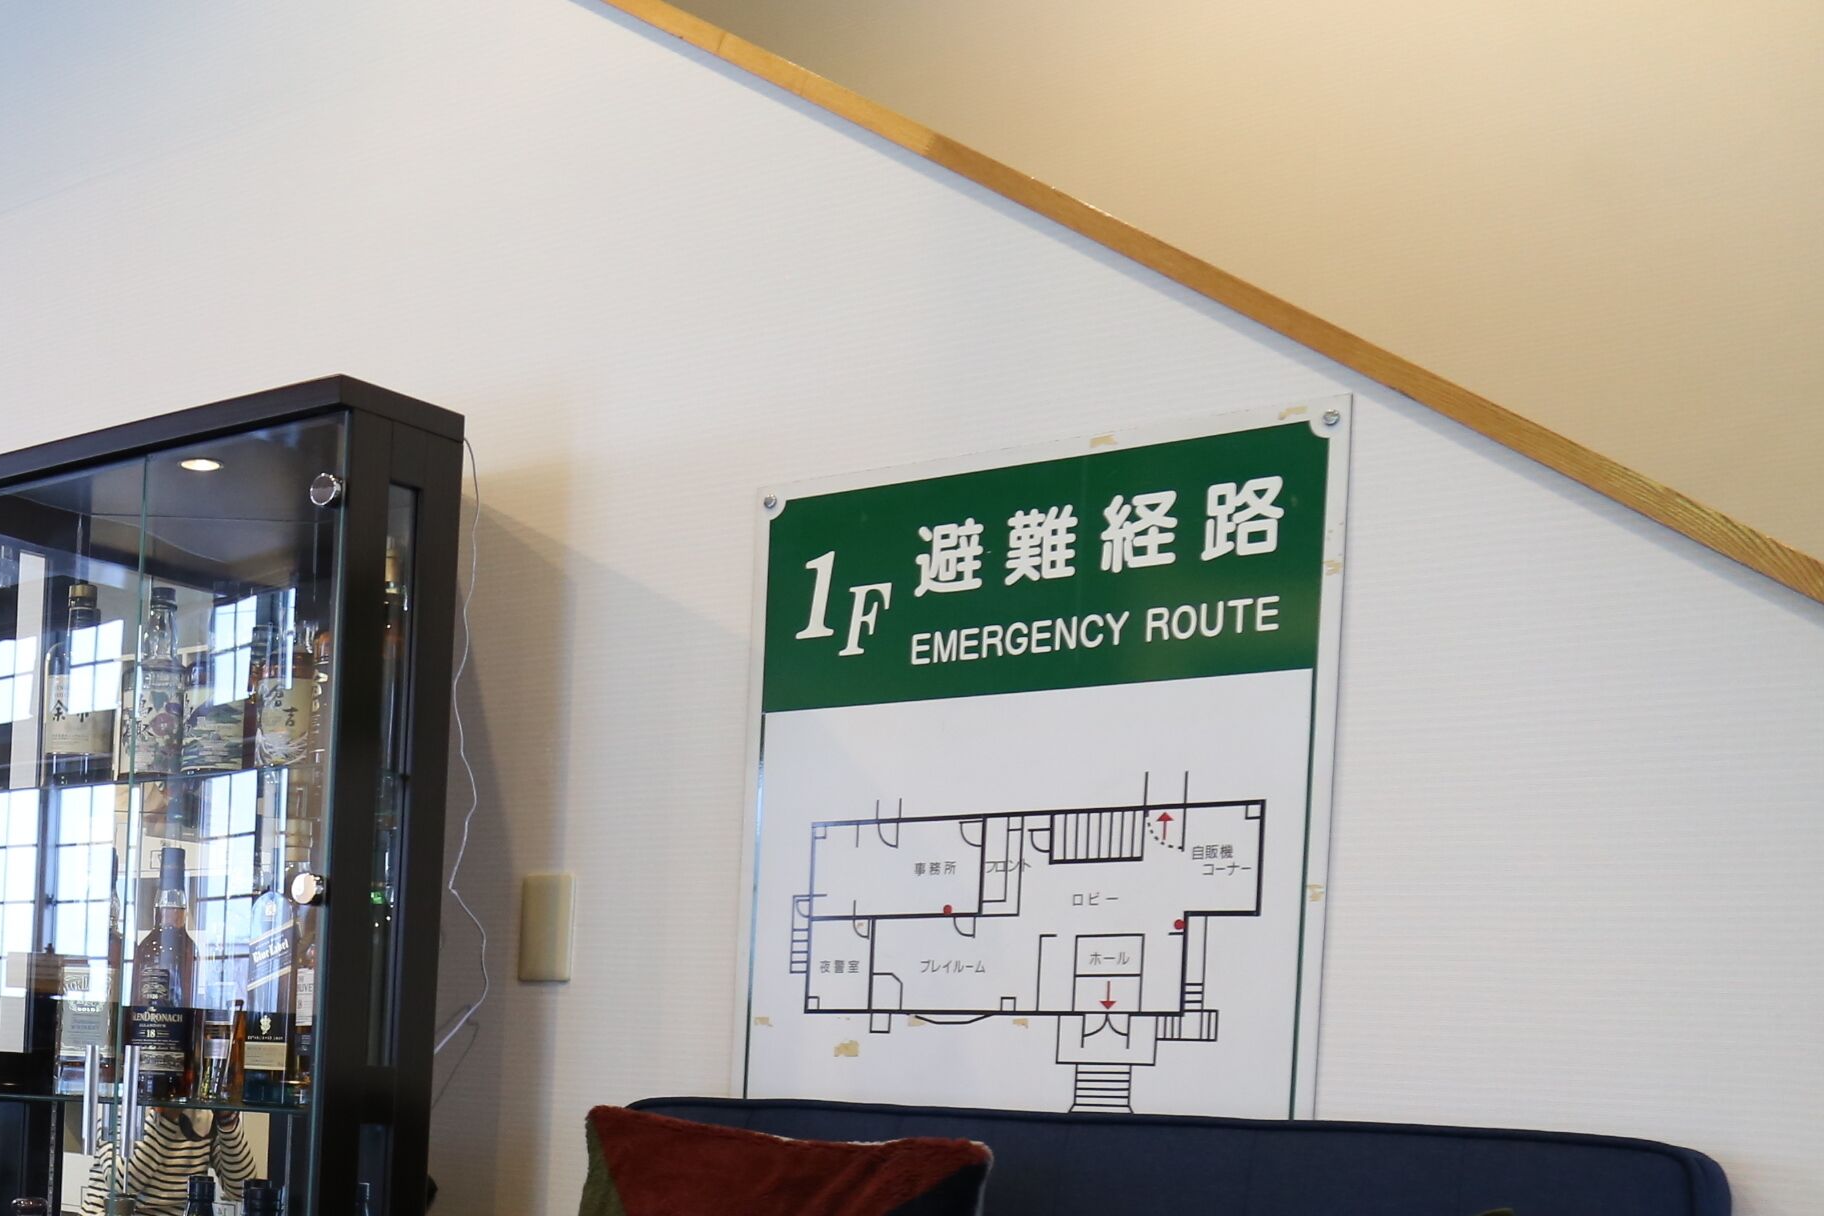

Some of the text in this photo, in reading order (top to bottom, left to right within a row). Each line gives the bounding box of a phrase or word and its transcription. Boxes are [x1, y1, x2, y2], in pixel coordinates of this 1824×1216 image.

[914, 475, 1284, 597] 避難経路
[795, 551, 892, 657] 1F
[911, 596, 1280, 665] EMERGENCY ROUTE
[1192, 844, 1234, 860] 自販機
[914, 861, 957, 876] 事務所
[1202, 863, 1252, 876] コーナー
[1072, 892, 1119, 906] ロビー
[1089, 951, 1130, 966] ホール
[133, 1012, 183, 1022] LENDRONACH
[146, 1029, 156, 1038] 18
